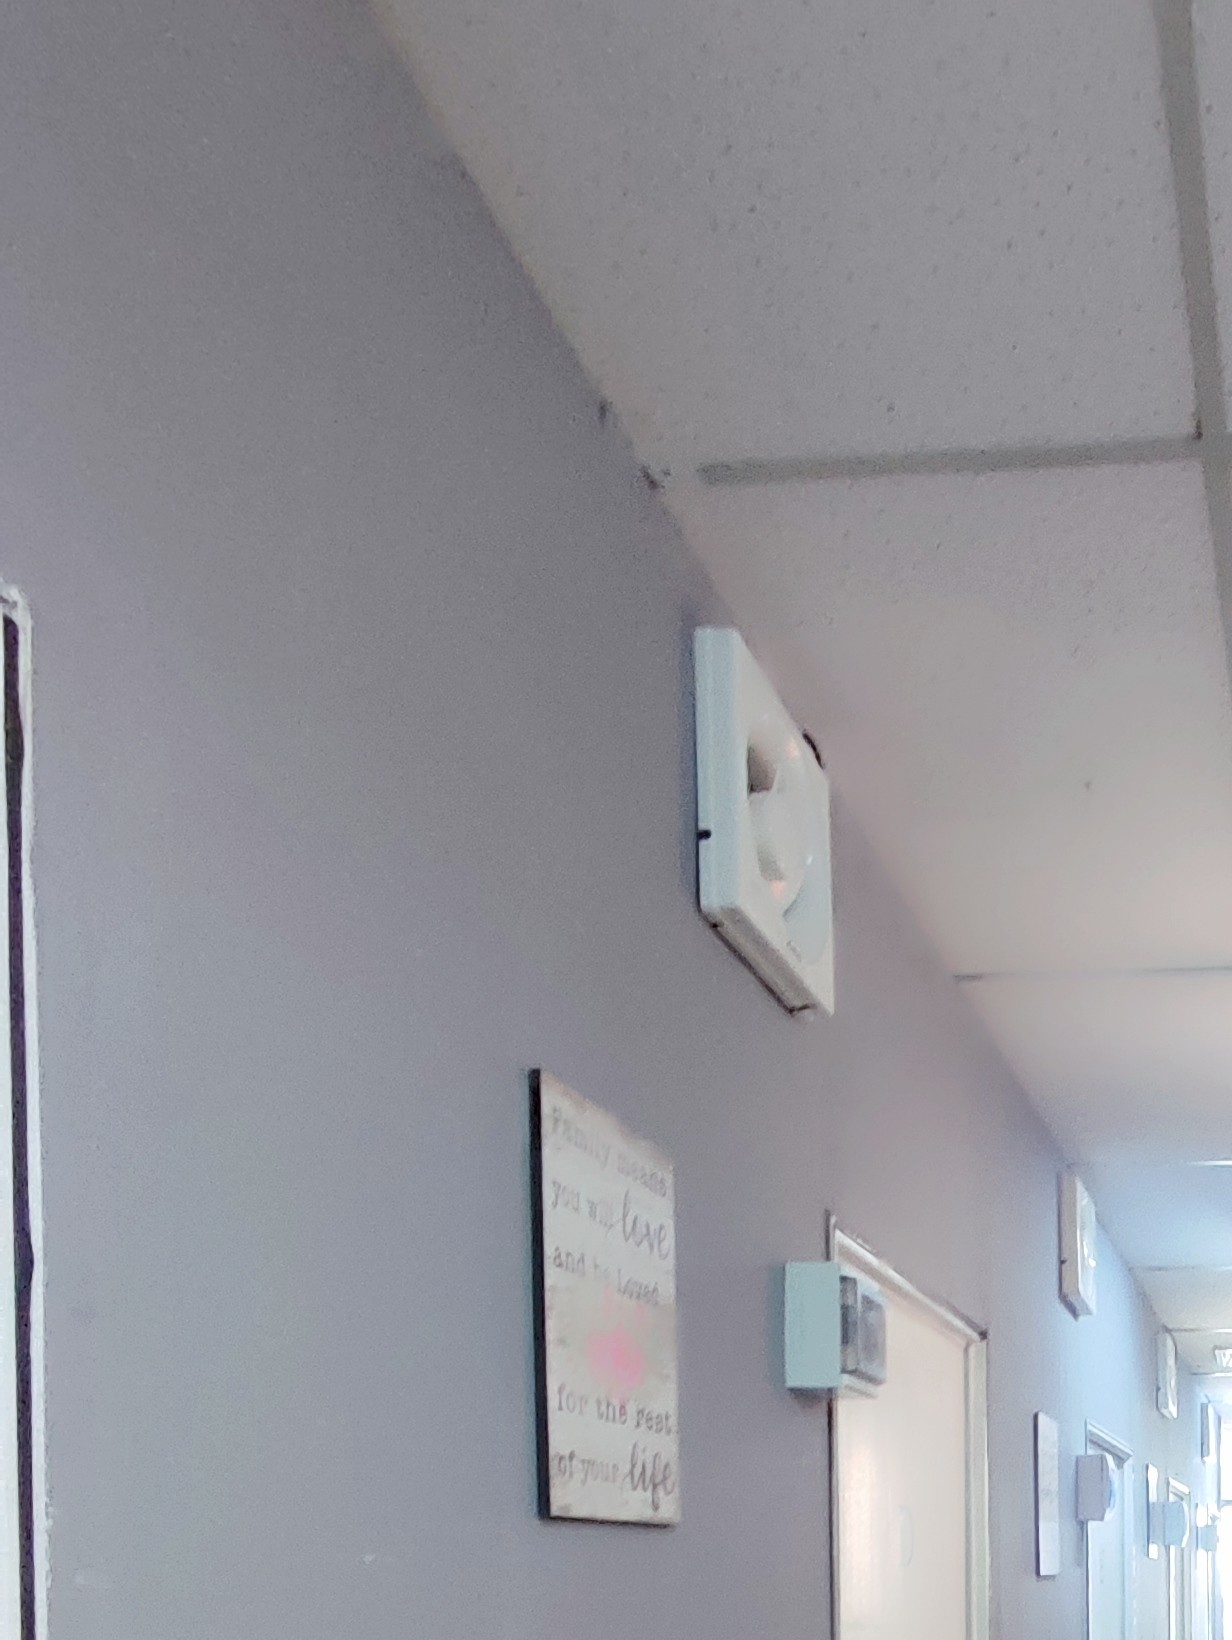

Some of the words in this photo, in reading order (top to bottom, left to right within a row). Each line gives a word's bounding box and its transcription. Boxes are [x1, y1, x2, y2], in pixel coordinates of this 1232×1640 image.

[553, 1246, 586, 1277] and
[557, 1383, 588, 1415] for
[596, 1397, 628, 1426] the
[635, 1407, 672, 1436] rest
[557, 1450, 576, 1479] of
[580, 1458, 619, 1487] your
[623, 1441, 676, 1512] life
